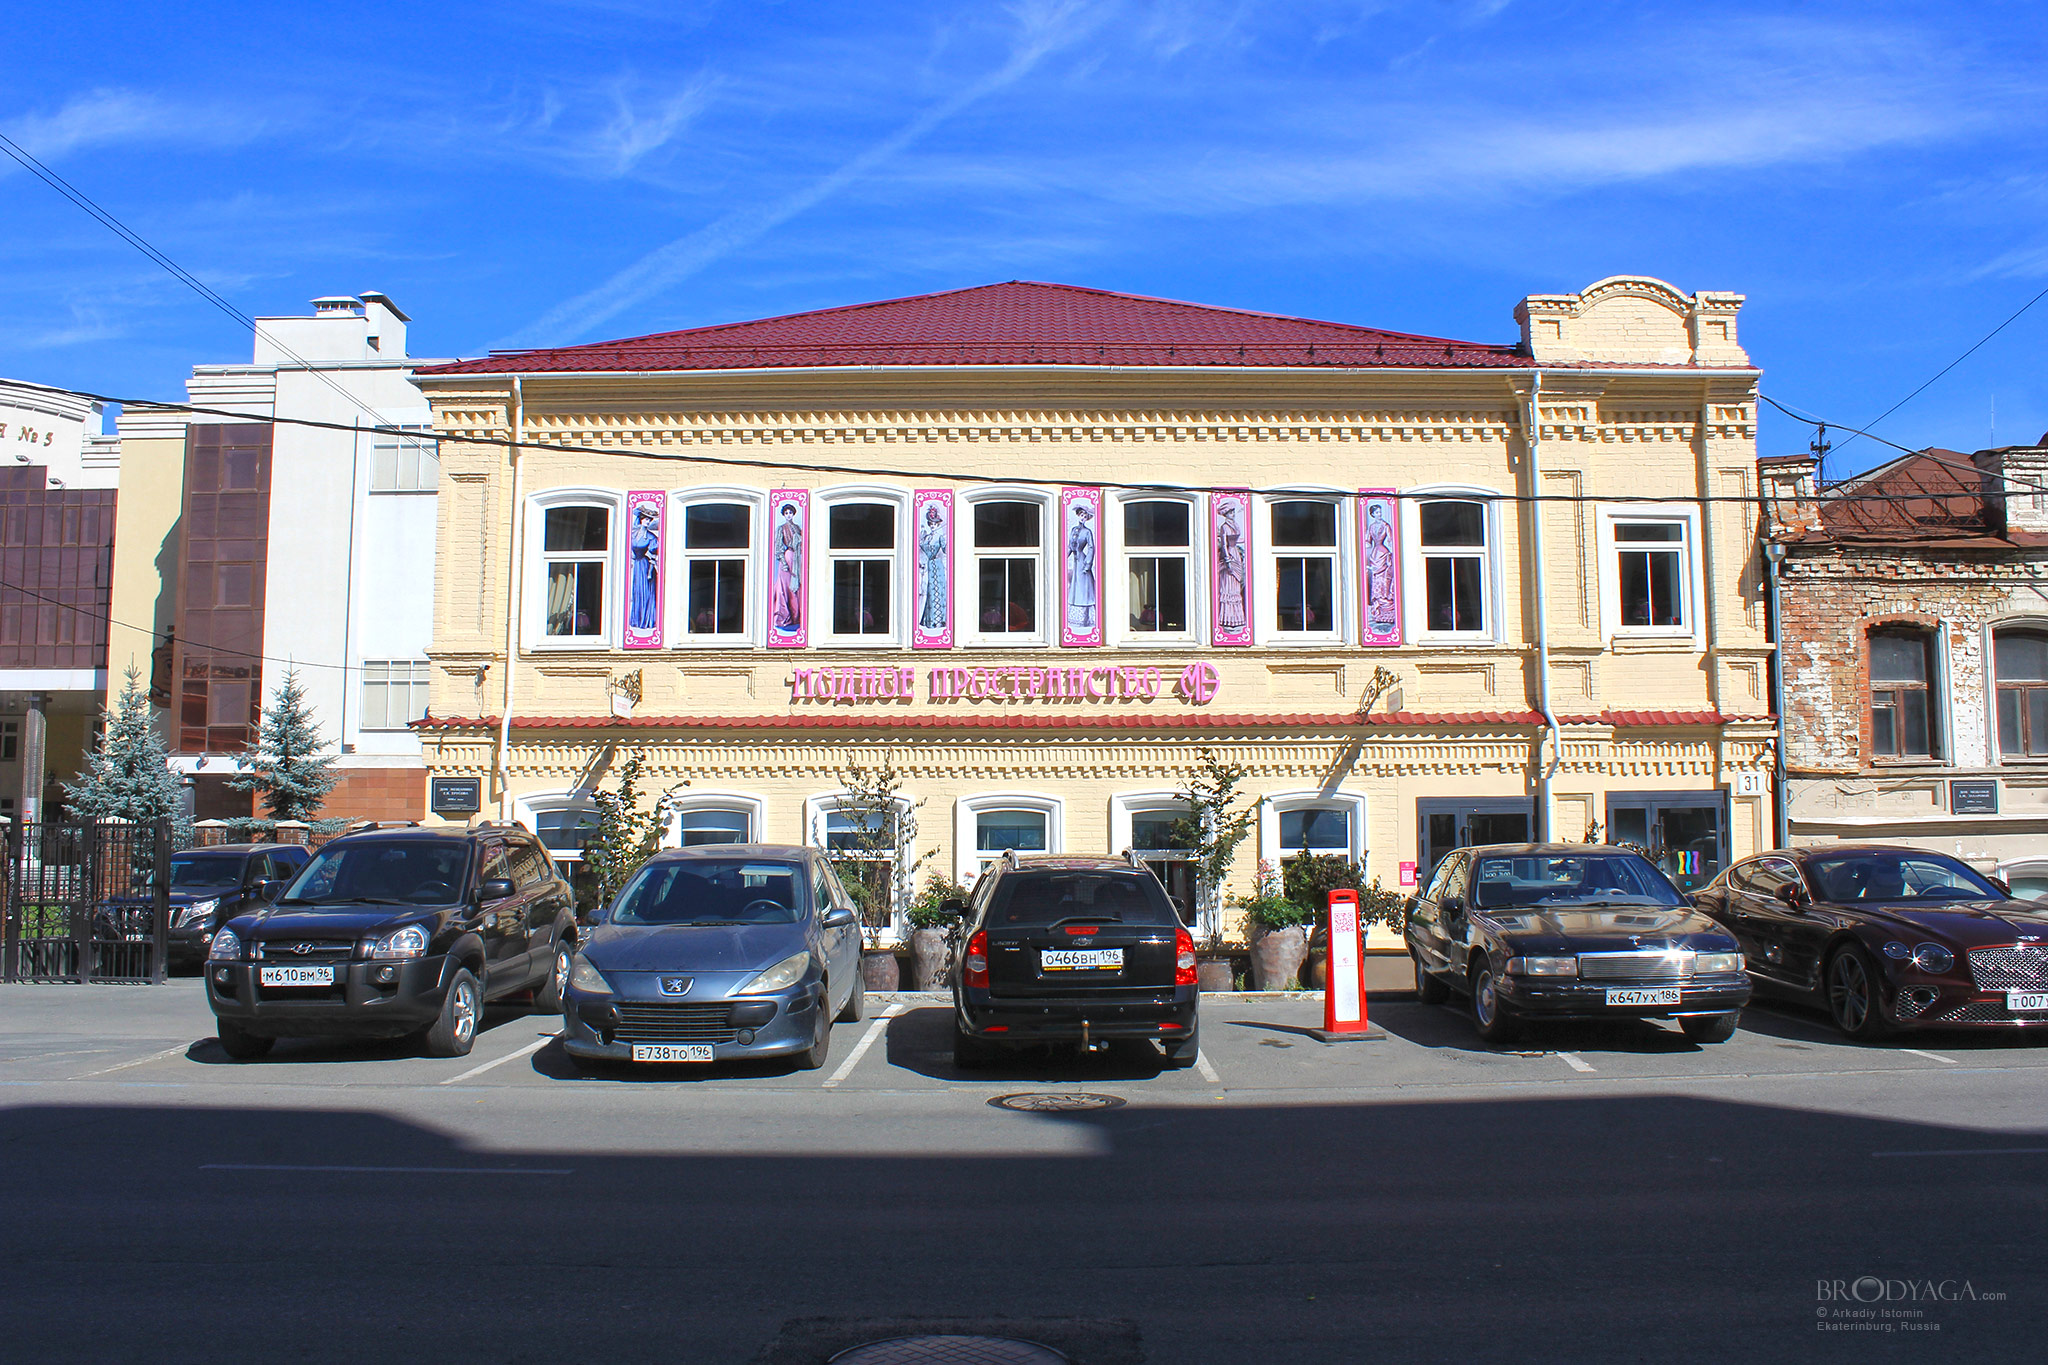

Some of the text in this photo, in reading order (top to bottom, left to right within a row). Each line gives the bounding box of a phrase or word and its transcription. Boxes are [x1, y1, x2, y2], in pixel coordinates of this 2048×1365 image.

[43, 431, 54, 447] 5
[792, 666, 1162, 701] МОДНОЕ ПРОСТРАНСТВО
[1744, 775, 1759, 791] 31
[1100, 951, 1119, 961] 196
[317, 968, 330, 978] 96
[1660, 990, 1679, 1000] 186
[690, 1046, 711, 1057] 196
